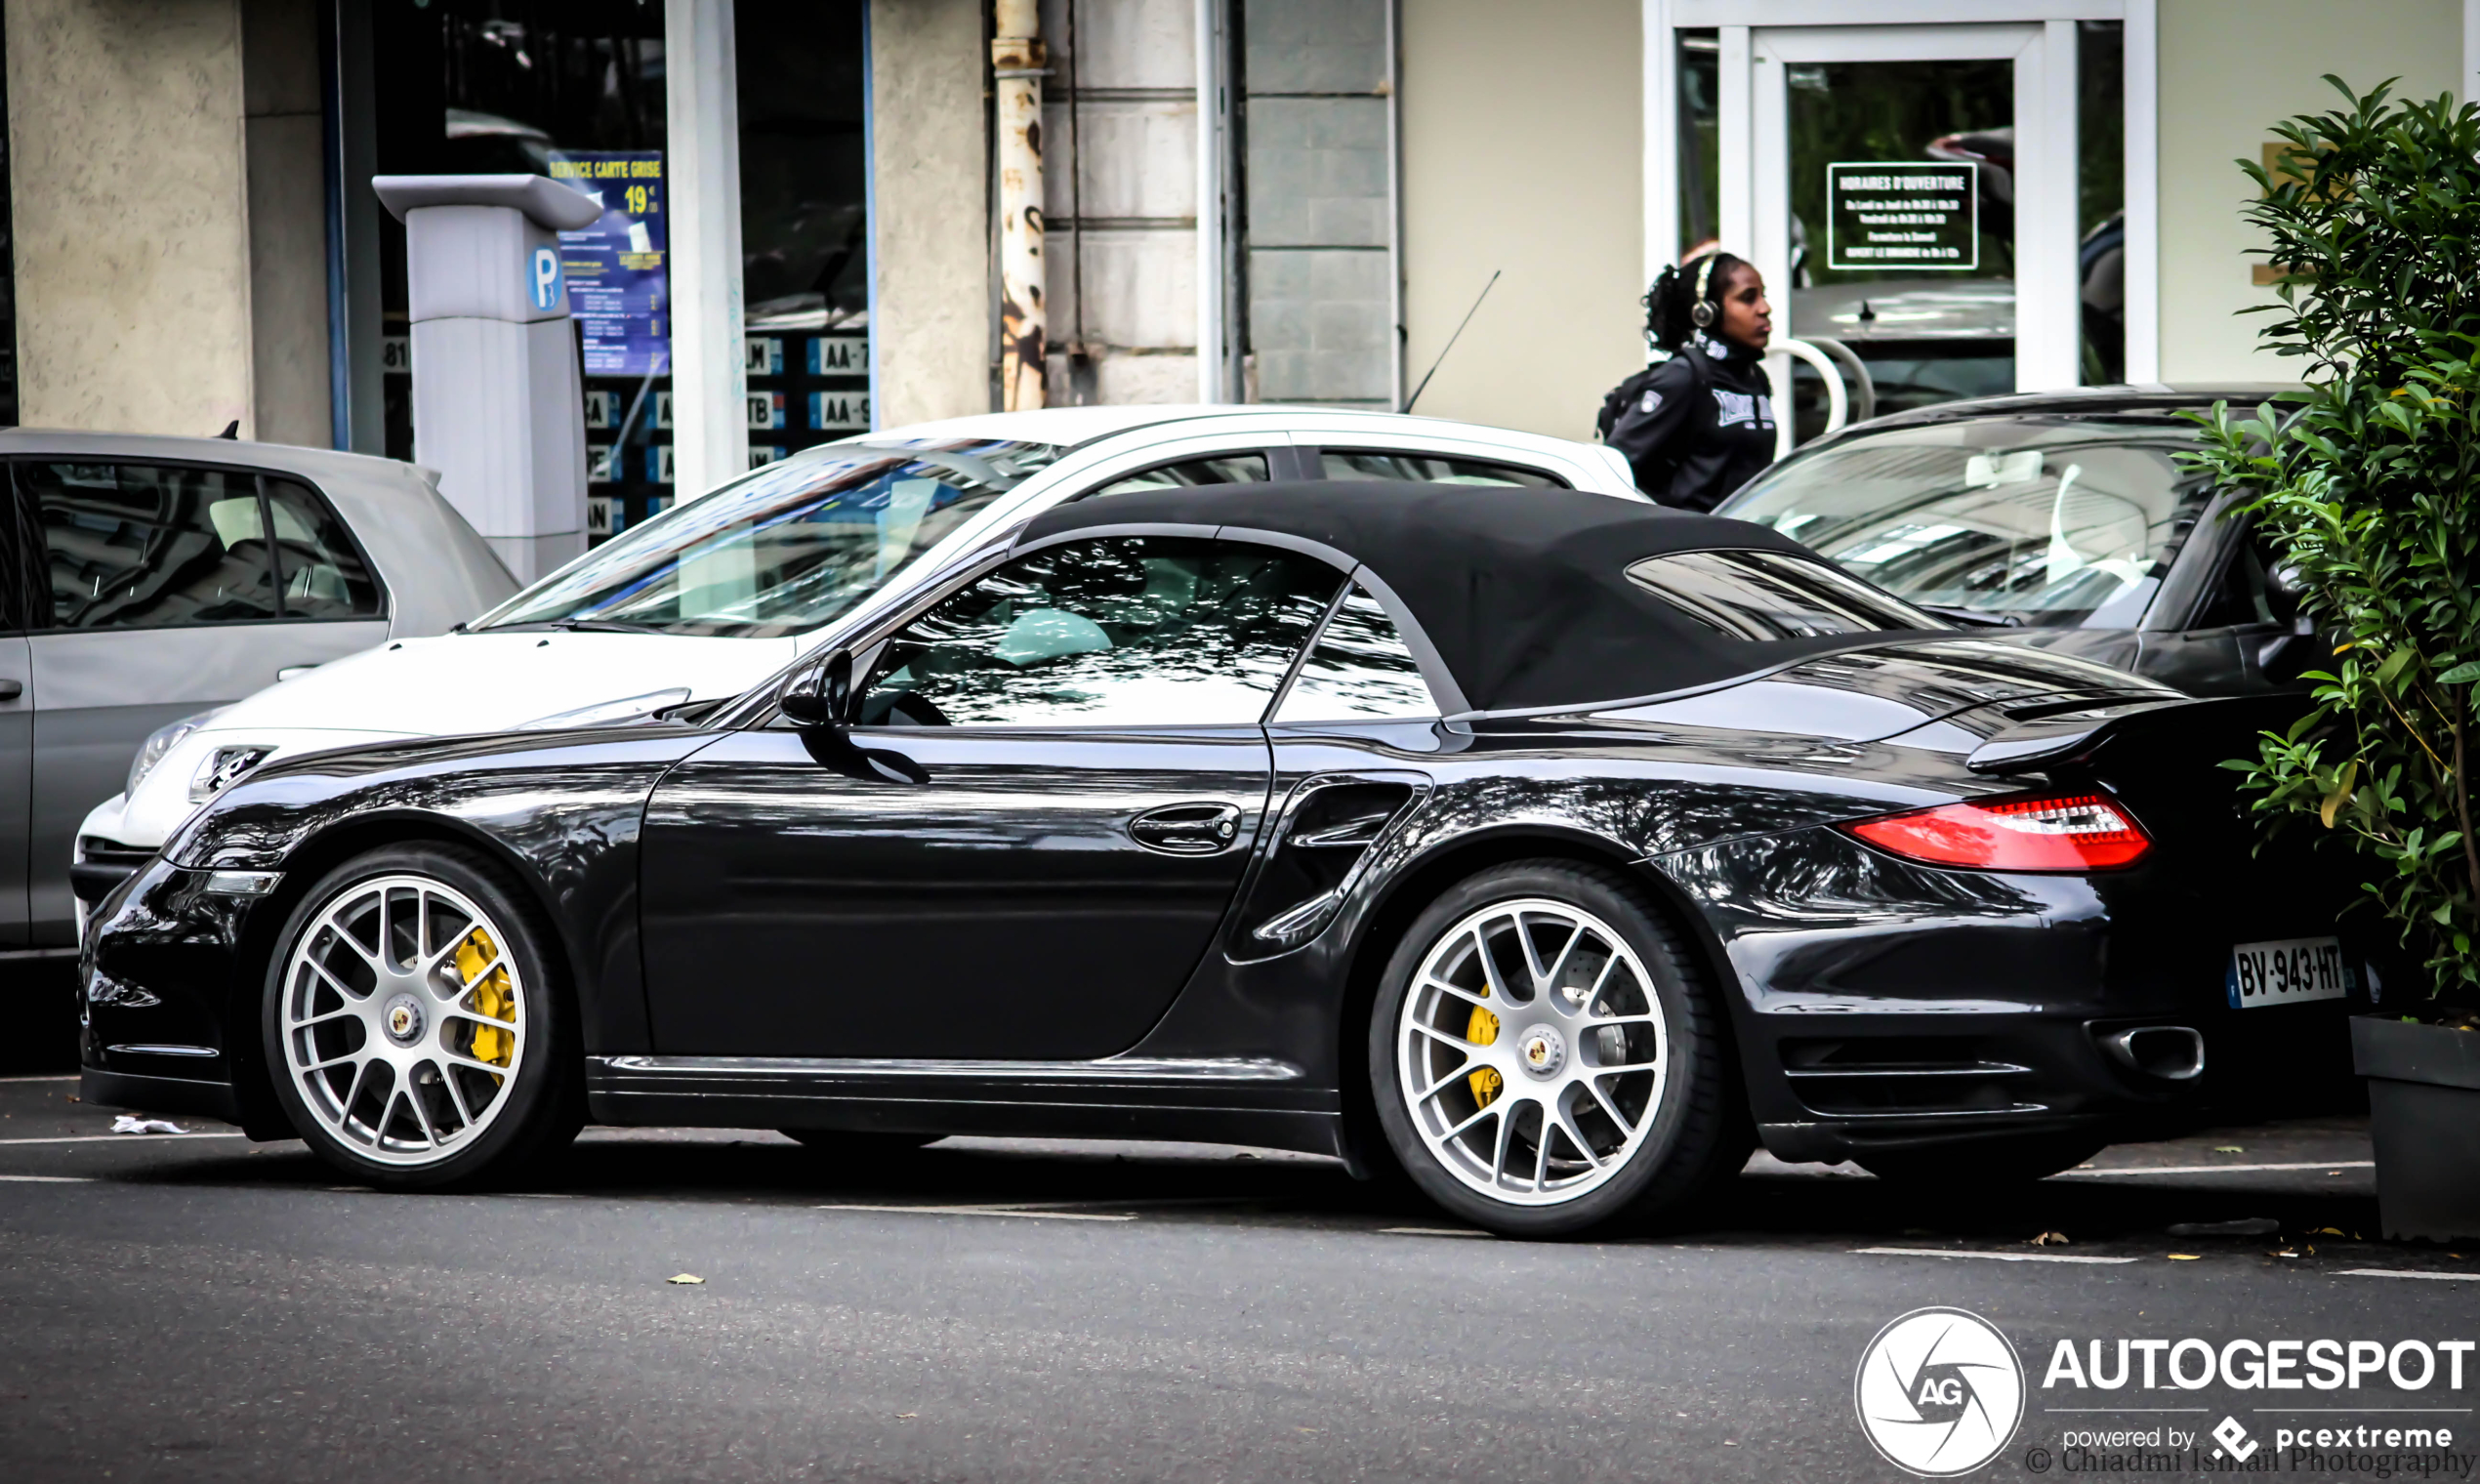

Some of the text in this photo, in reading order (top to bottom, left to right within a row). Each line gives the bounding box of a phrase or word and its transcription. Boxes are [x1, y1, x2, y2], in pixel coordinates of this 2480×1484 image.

[550, 161, 661, 178] SERVICE CARTE GRISE
[1839, 176, 1965, 190] HORAIRES D'OUVERTURE
[625, 186, 647, 214] 19
[536, 249, 558, 308] P
[746, 343, 765, 369] M
[586, 396, 602, 423] A
[2238, 945, 2340, 997] BV-943-HT
